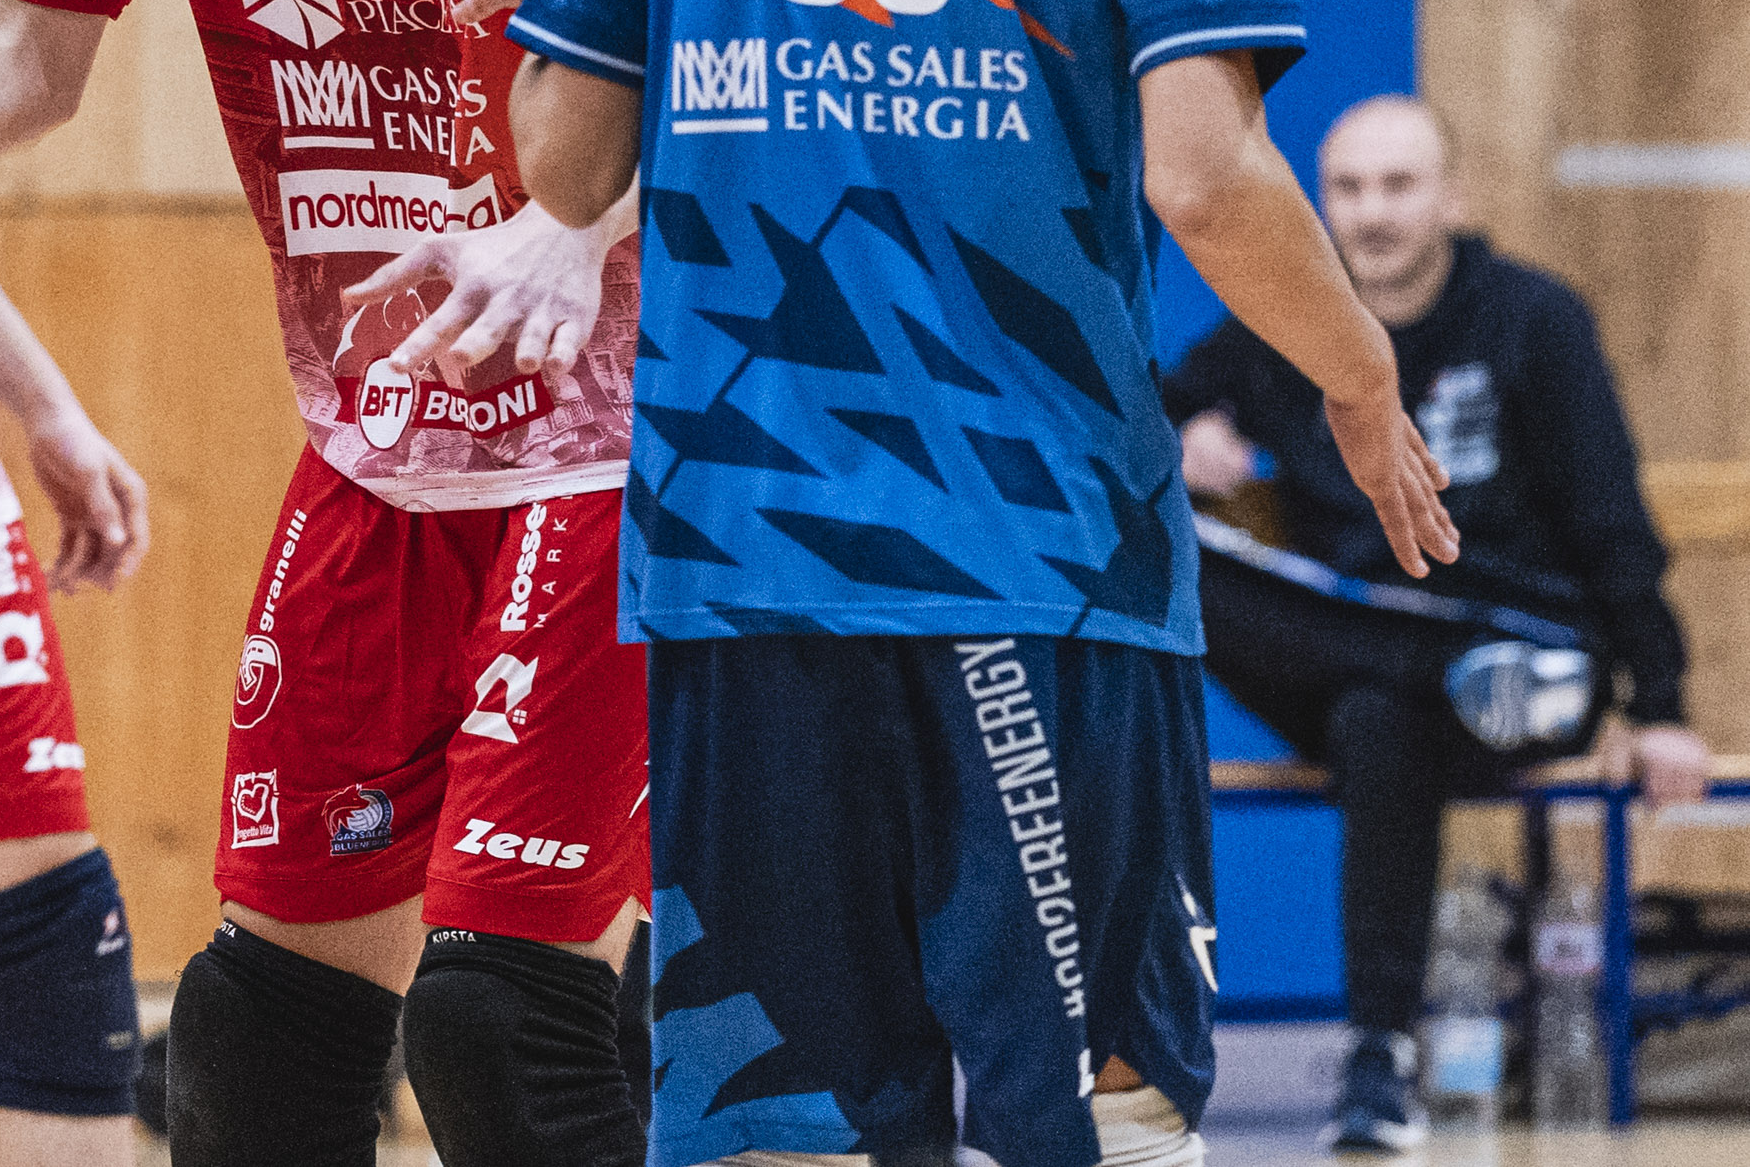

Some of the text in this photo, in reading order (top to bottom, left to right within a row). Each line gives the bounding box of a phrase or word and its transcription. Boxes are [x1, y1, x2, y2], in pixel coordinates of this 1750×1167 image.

[369, 65, 442, 105] GAS
[775, 37, 1029, 93] GAS SALES
[783, 88, 1031, 142] ENERGIA
[361, 385, 412, 418] BFT
[259, 508, 308, 633] granelli
[452, 817, 591, 870] Zeus
[431, 930, 477, 944] KIPSTA
